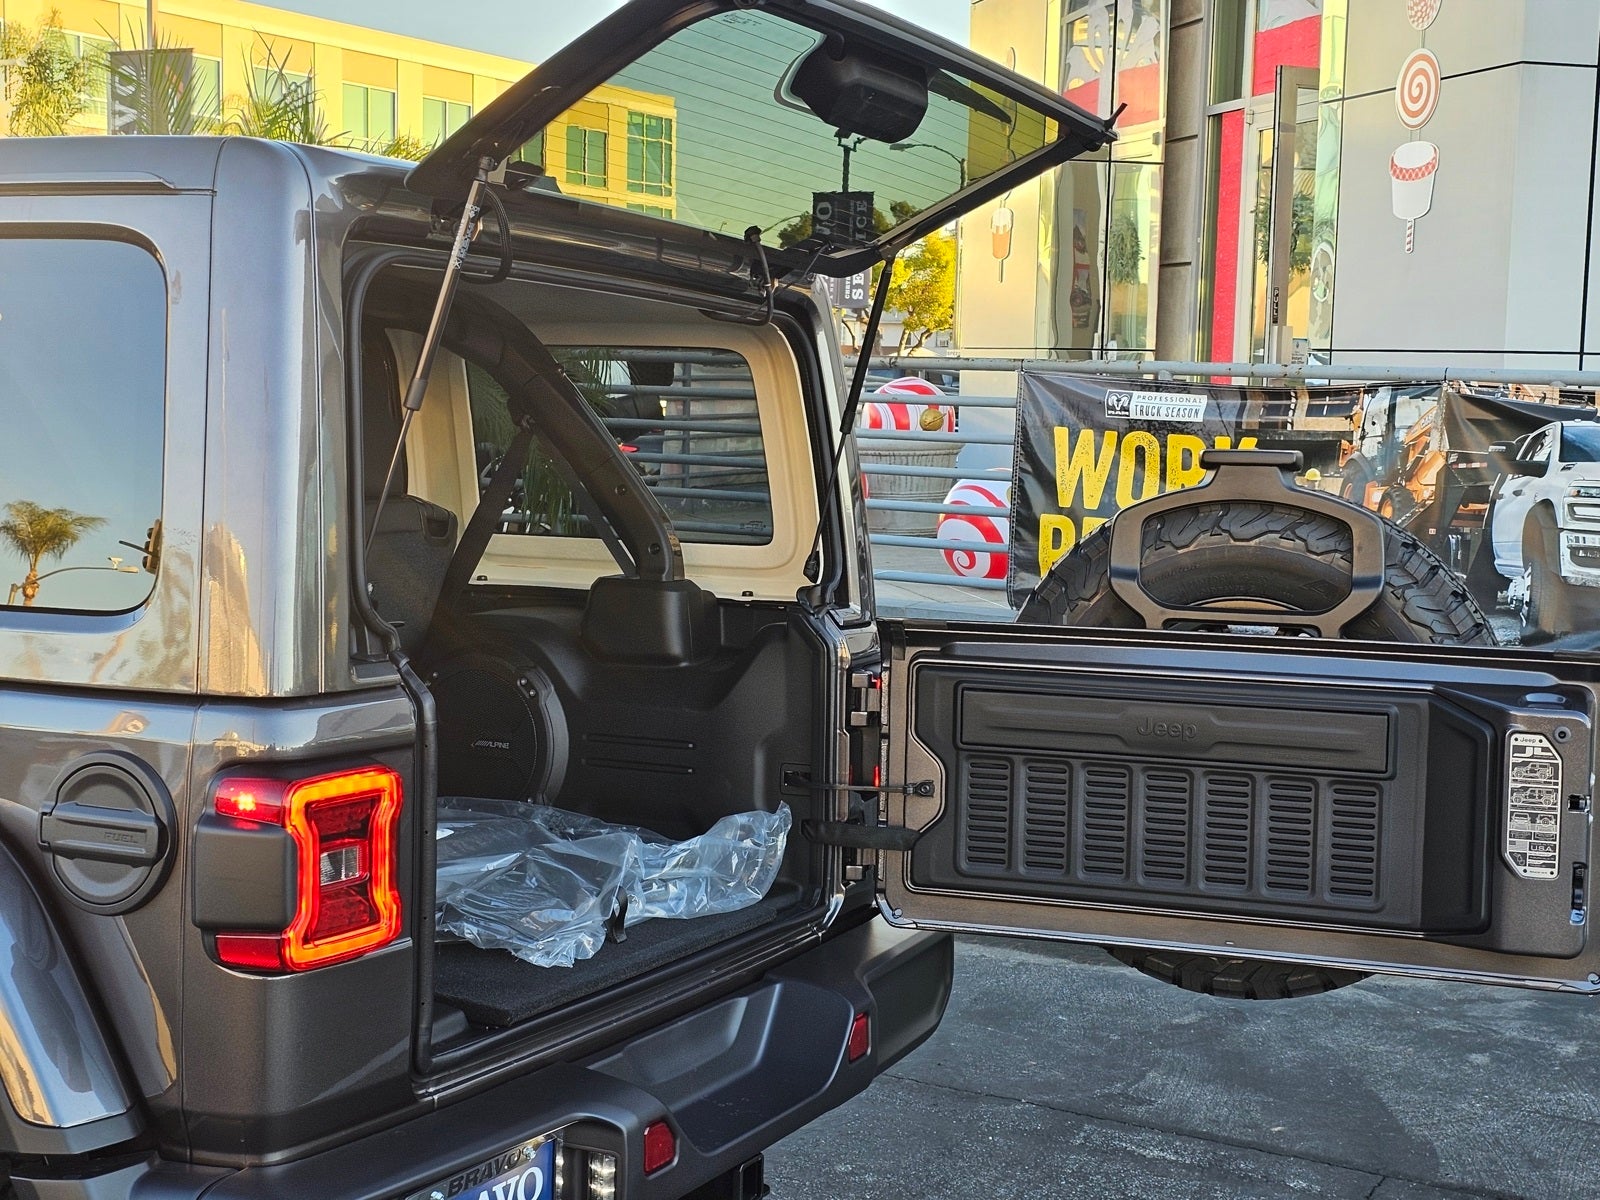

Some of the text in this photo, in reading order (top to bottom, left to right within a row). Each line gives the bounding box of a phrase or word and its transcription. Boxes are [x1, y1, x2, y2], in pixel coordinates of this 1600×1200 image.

[1136, 394, 1203, 404] PROFESSIONAL
[1134, 404, 1201, 419] TRUCK SEASON
[1053, 426, 1257, 510] WOR
[1137, 717, 1197, 741] Jeep
[482, 740, 510, 749] ALPINE
[104, 831, 139, 844] FUEL
[447, 1148, 521, 1197] BRAVO
